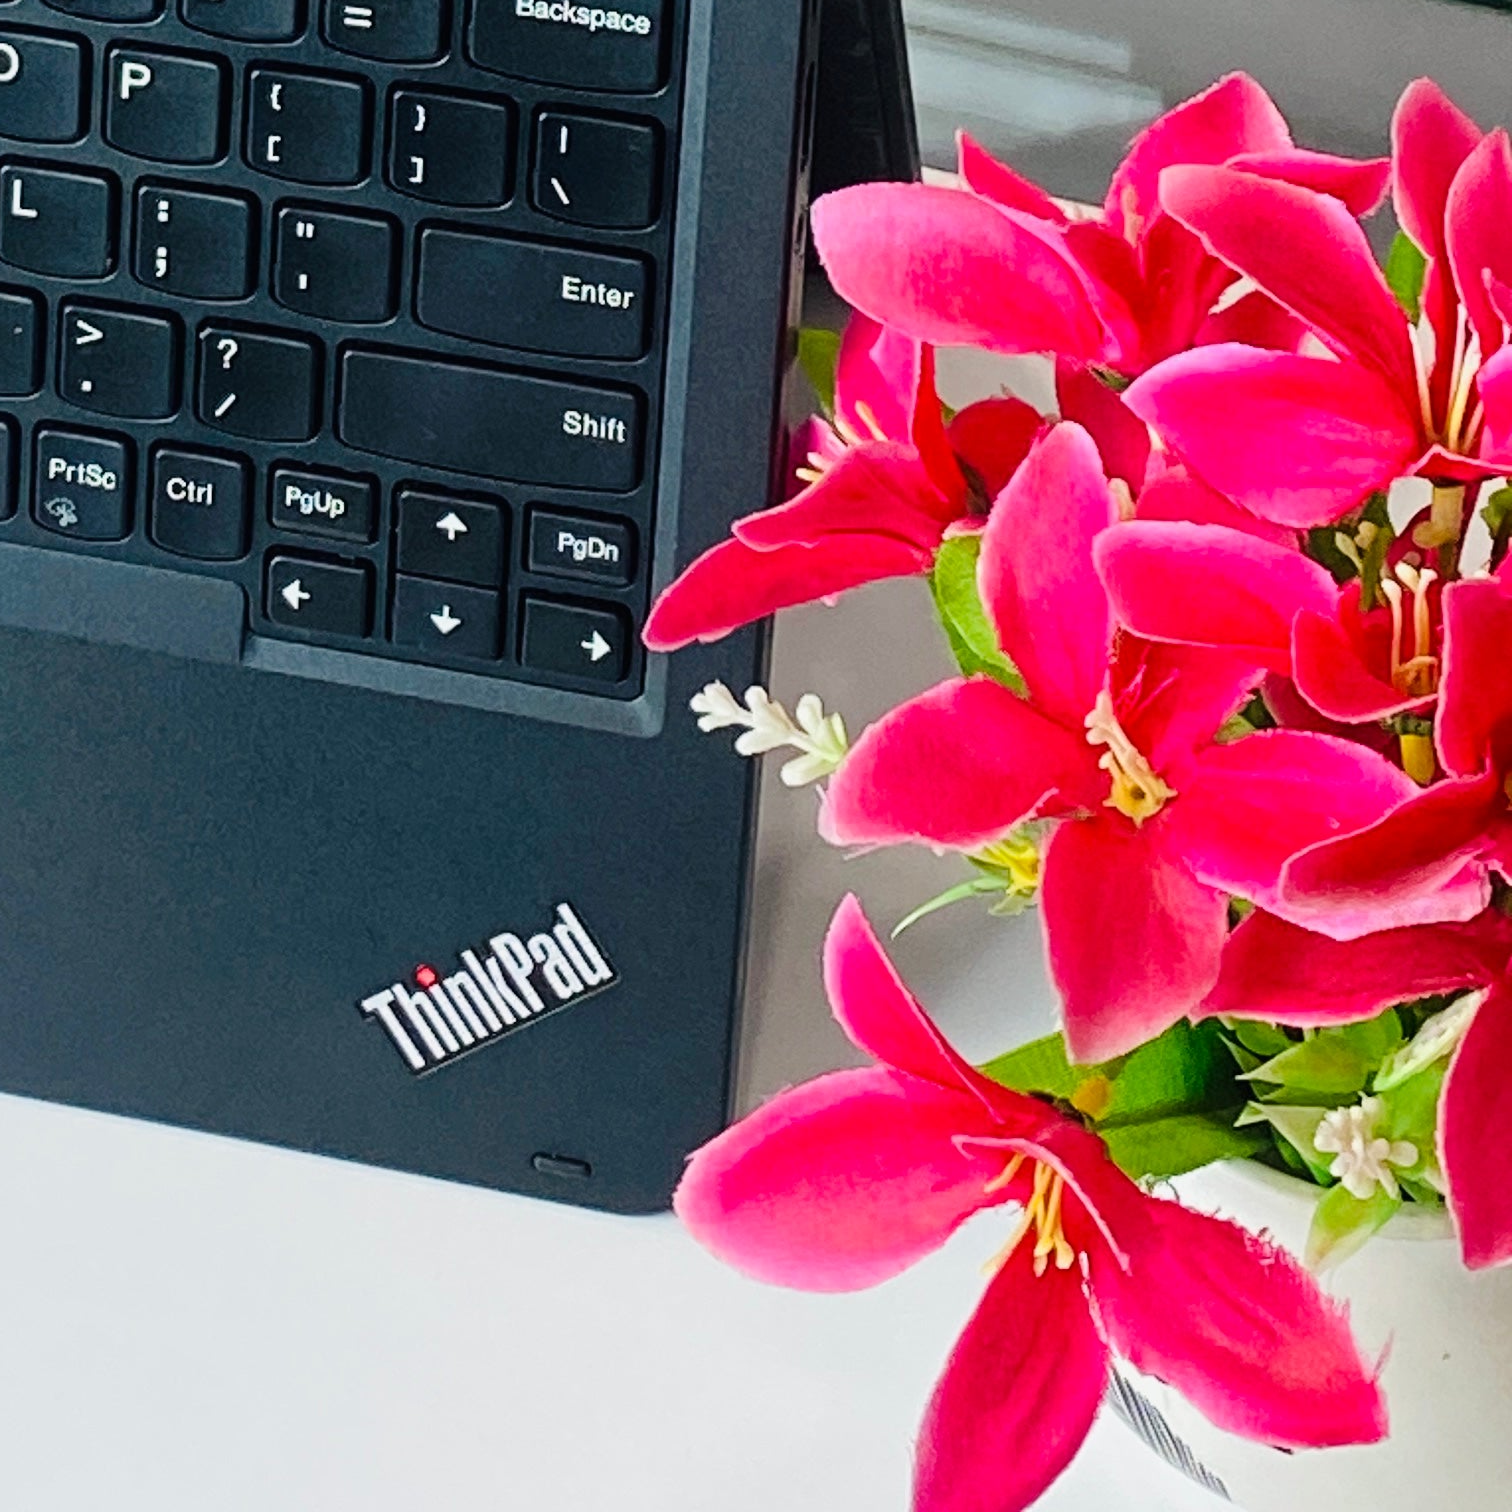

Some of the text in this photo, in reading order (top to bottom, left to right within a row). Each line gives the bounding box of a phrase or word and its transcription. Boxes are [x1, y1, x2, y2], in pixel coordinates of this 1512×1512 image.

[343, 5, 373, 28] =
[120, 61, 151, 100] P
[11, 179, 38, 218] L
[561, 275, 635, 309] Enter
[76, 319, 104, 345] >
[217, 338, 238, 369] ?
[214, 393, 236, 417] /
[562, 410, 626, 443] Shift
[48, 457, 116, 490] PrtSc
[166, 477, 213, 505] Ctrl
[285, 485, 345, 519] PgUp
[557, 531, 619, 562] PgDn
[360, 902, 614, 1070] ThinkPad
